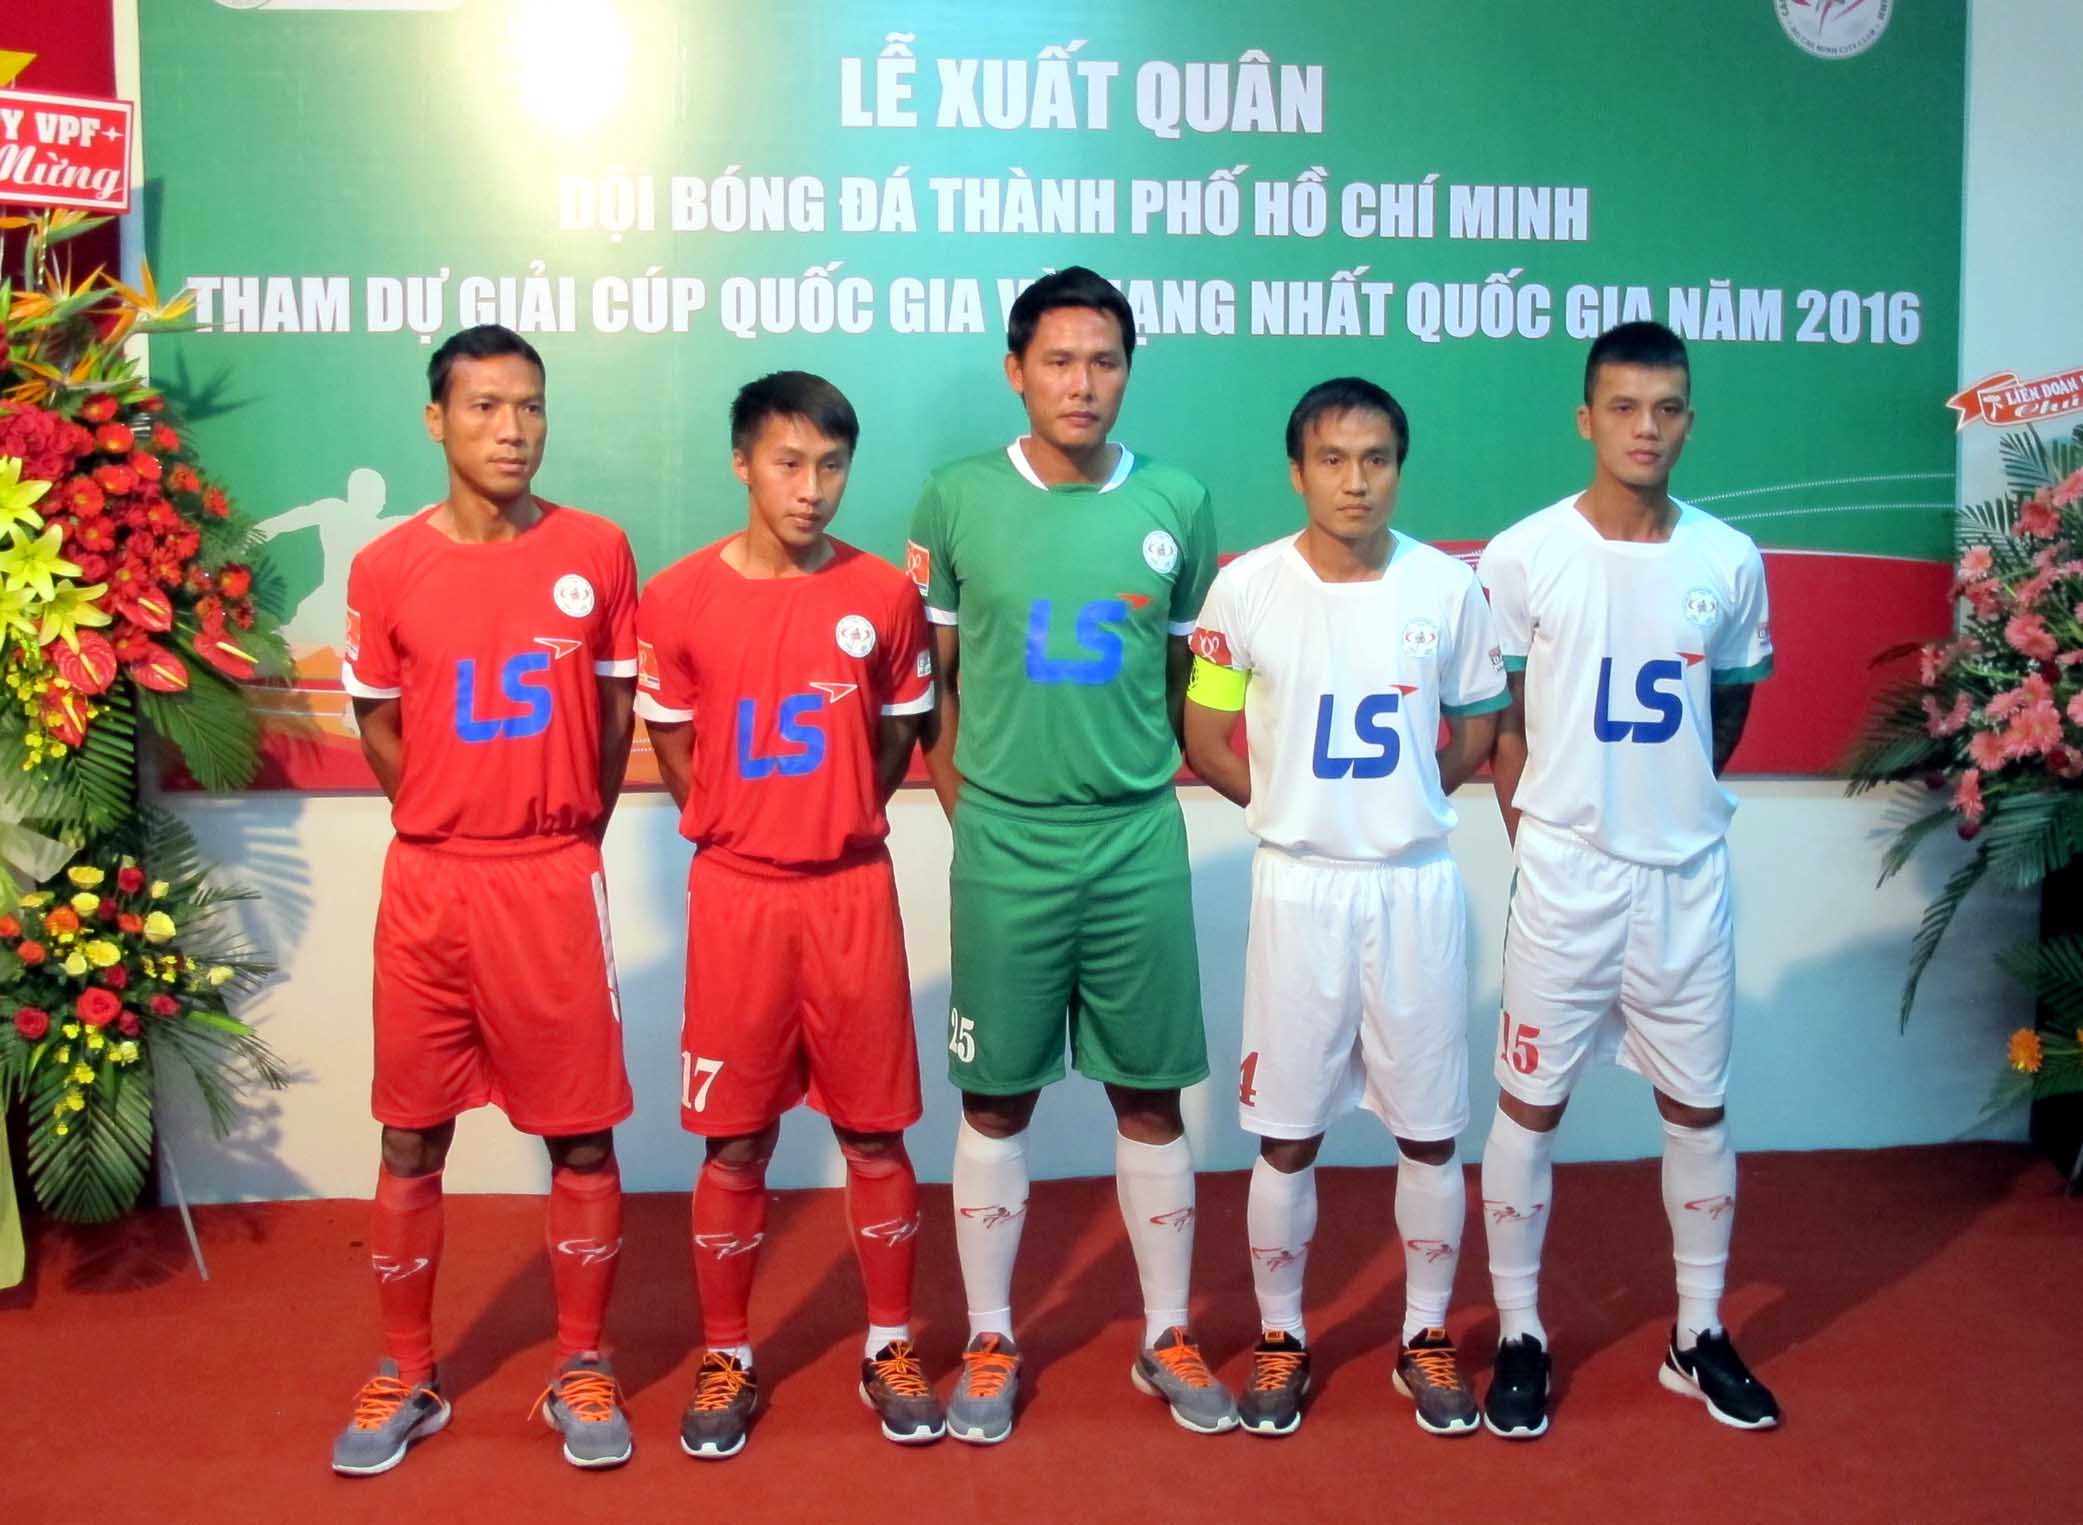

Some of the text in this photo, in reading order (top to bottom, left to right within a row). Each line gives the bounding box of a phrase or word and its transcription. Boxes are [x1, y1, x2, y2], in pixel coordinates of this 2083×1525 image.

[0, 108, 101, 148] Y VPF
[841, 32, 1323, 138] LỄ XUẤT QUÂN
[671, 165, 825, 232] BÓNG
[839, 166, 917, 232] ĐÁ
[930, 167, 1114, 234] THÀNH
[1132, 165, 1248, 236] PHỐ
[1255, 166, 1328, 236] HỒ
[1341, 174, 1440, 238] CHÍ
[1450, 185, 1588, 240] MINH
[187, 276, 350, 333] THAM
[366, 267, 449, 345] DỰ
[459, 259, 576, 332] GIẢI
[592, 266, 706, 333] CÚP
[720, 261, 875, 338] QUỐC
[889, 277, 985, 334] GIA
[1116, 280, 1236, 346] ẠNG
[1249, 265, 1393, 335] NHẤT
[1407, 268, 1551, 342] QUỐC
[1668, 278, 1782, 342] NĂM
[1796, 290, 1921, 345] 2016
[1022, 599, 1126, 686] LS
[455, 652, 552, 742] LS
[737, 692, 825, 780] LS
[1312, 693, 1401, 779] LS
[1593, 656, 1682, 743] LS
[949, 1007, 975, 1062] 25
[1500, 1010, 1540, 1074] 15
[681, 1050, 724, 1112] 17
